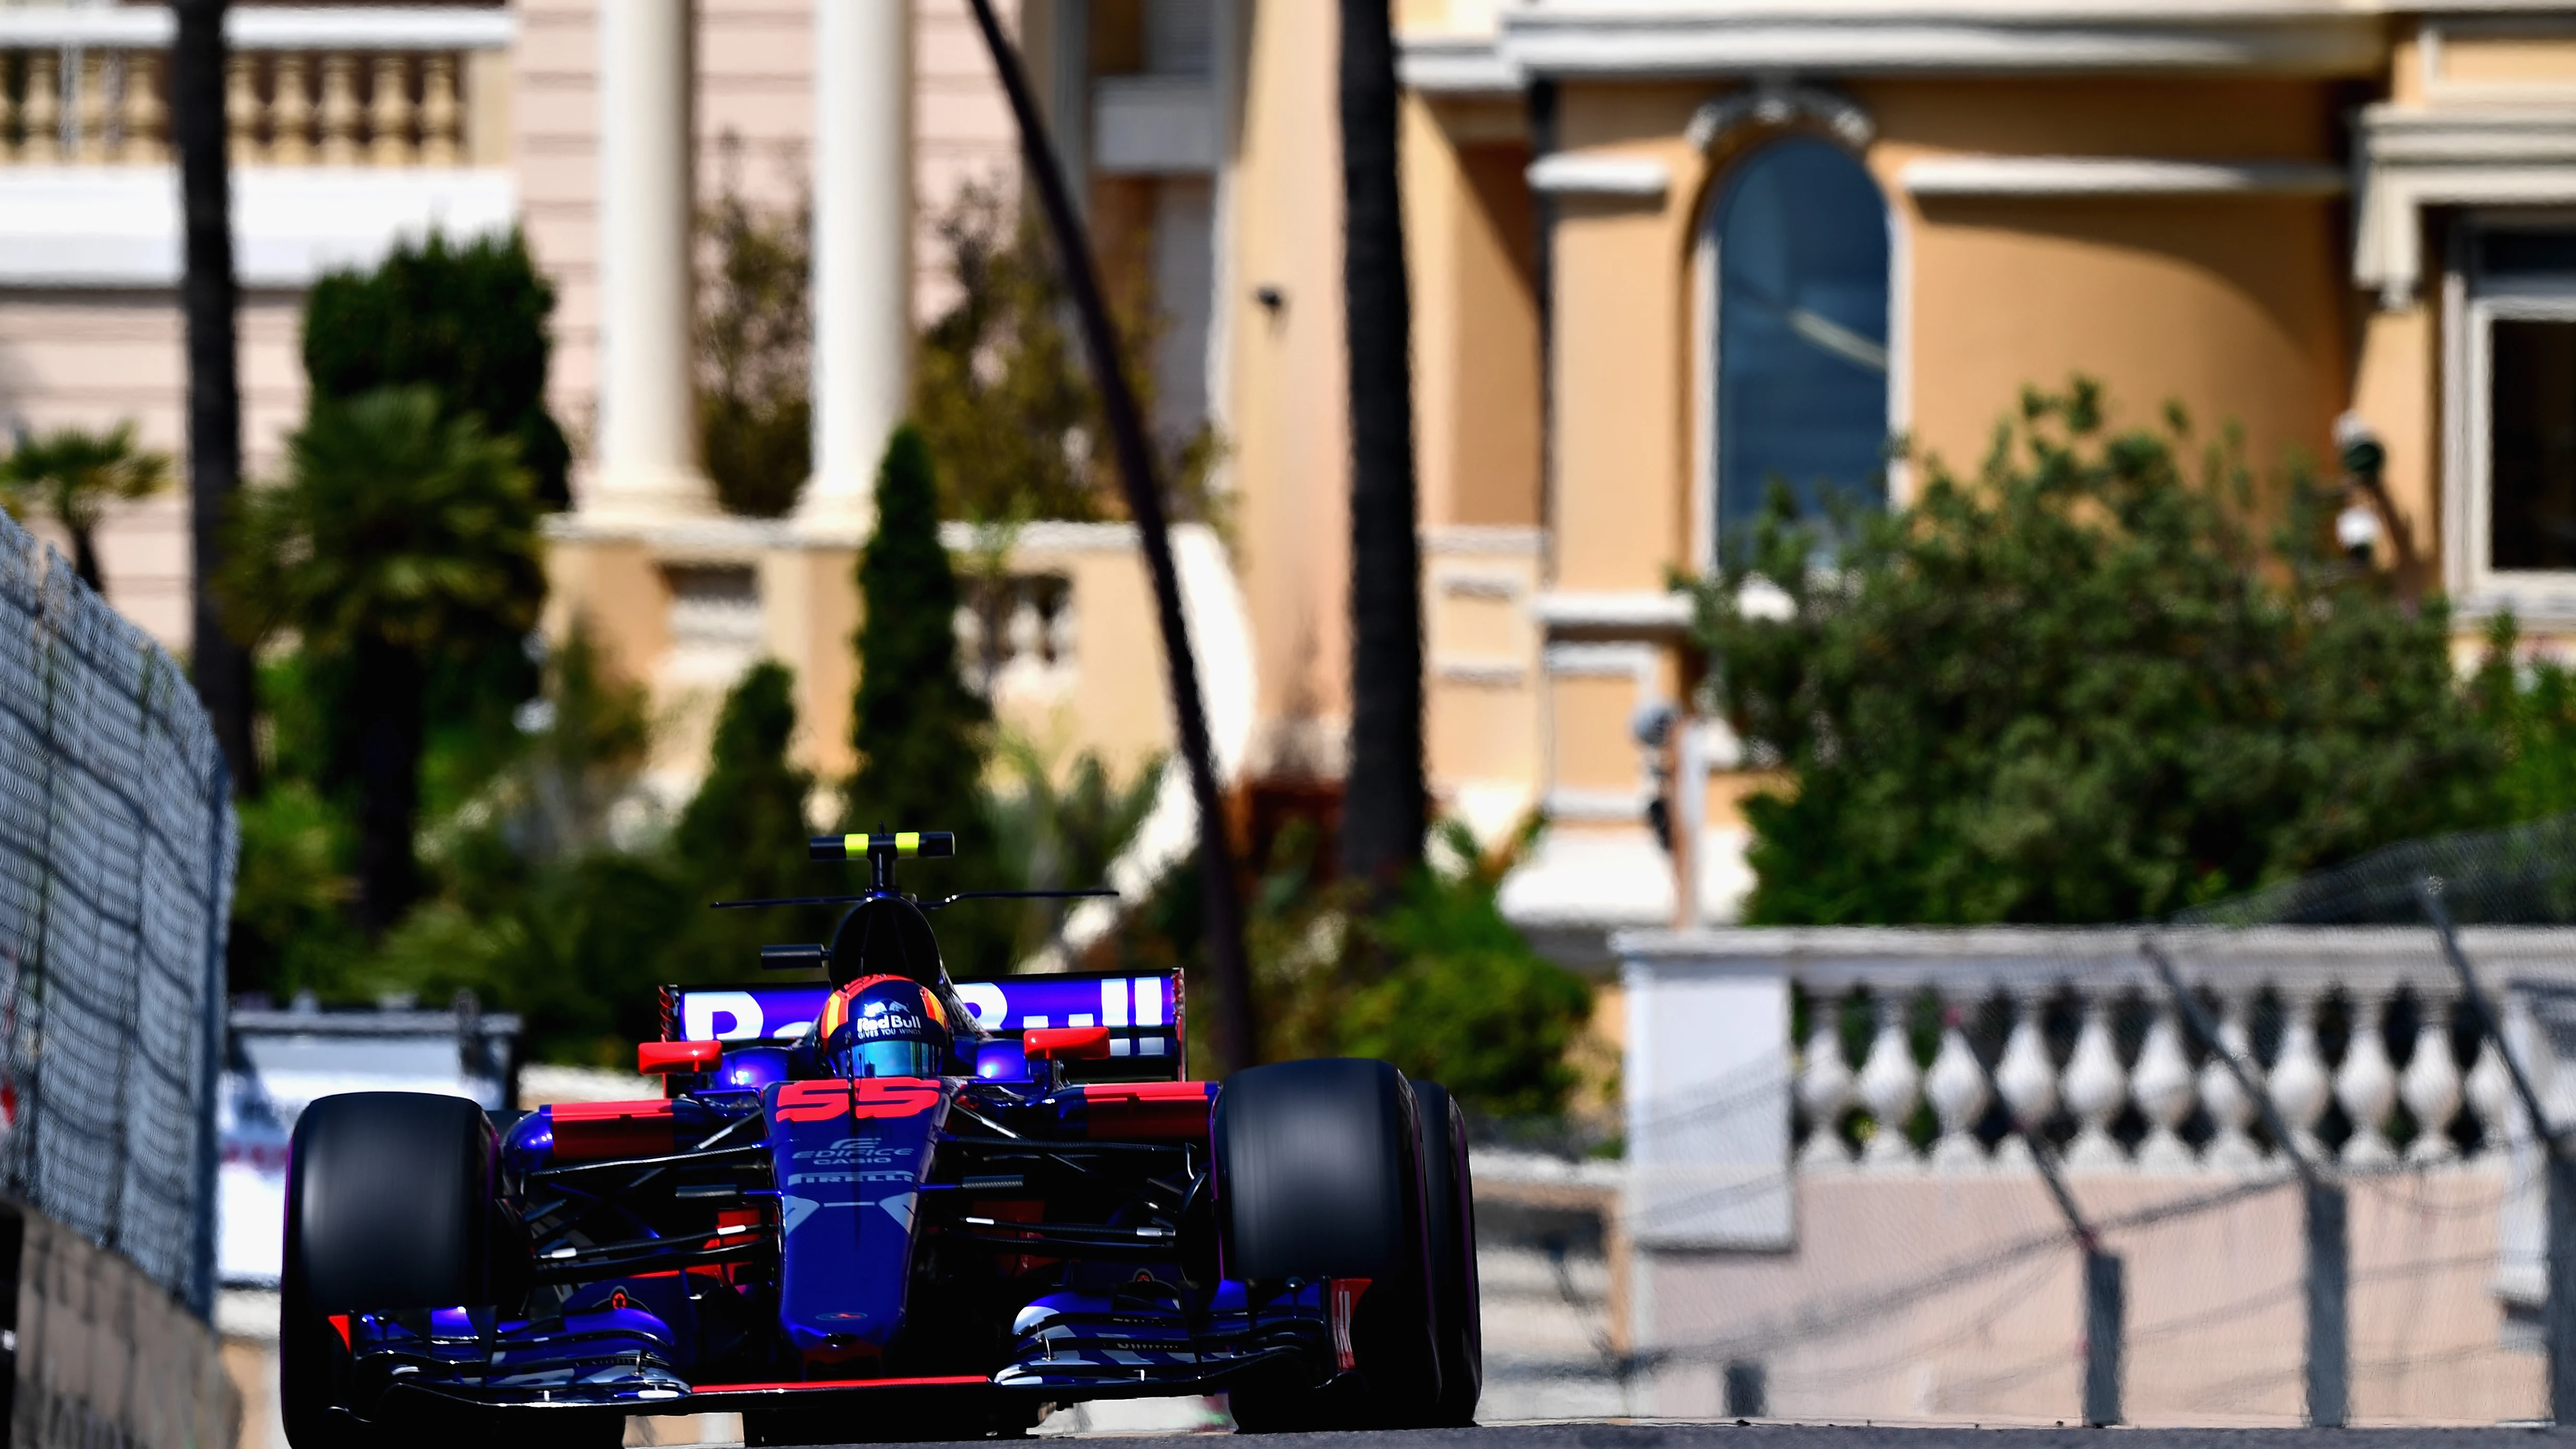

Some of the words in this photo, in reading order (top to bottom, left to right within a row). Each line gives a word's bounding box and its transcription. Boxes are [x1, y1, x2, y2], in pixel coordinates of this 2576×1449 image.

[857, 1015, 889, 1032] Red
[891, 1015, 921, 1029] Bull
[858, 1028, 879, 1039] GIVES
[776, 1077, 941, 1122] 55
[792, 1148, 915, 1159] EDIFICE
[788, 1170, 915, 1186] PIRELLI
